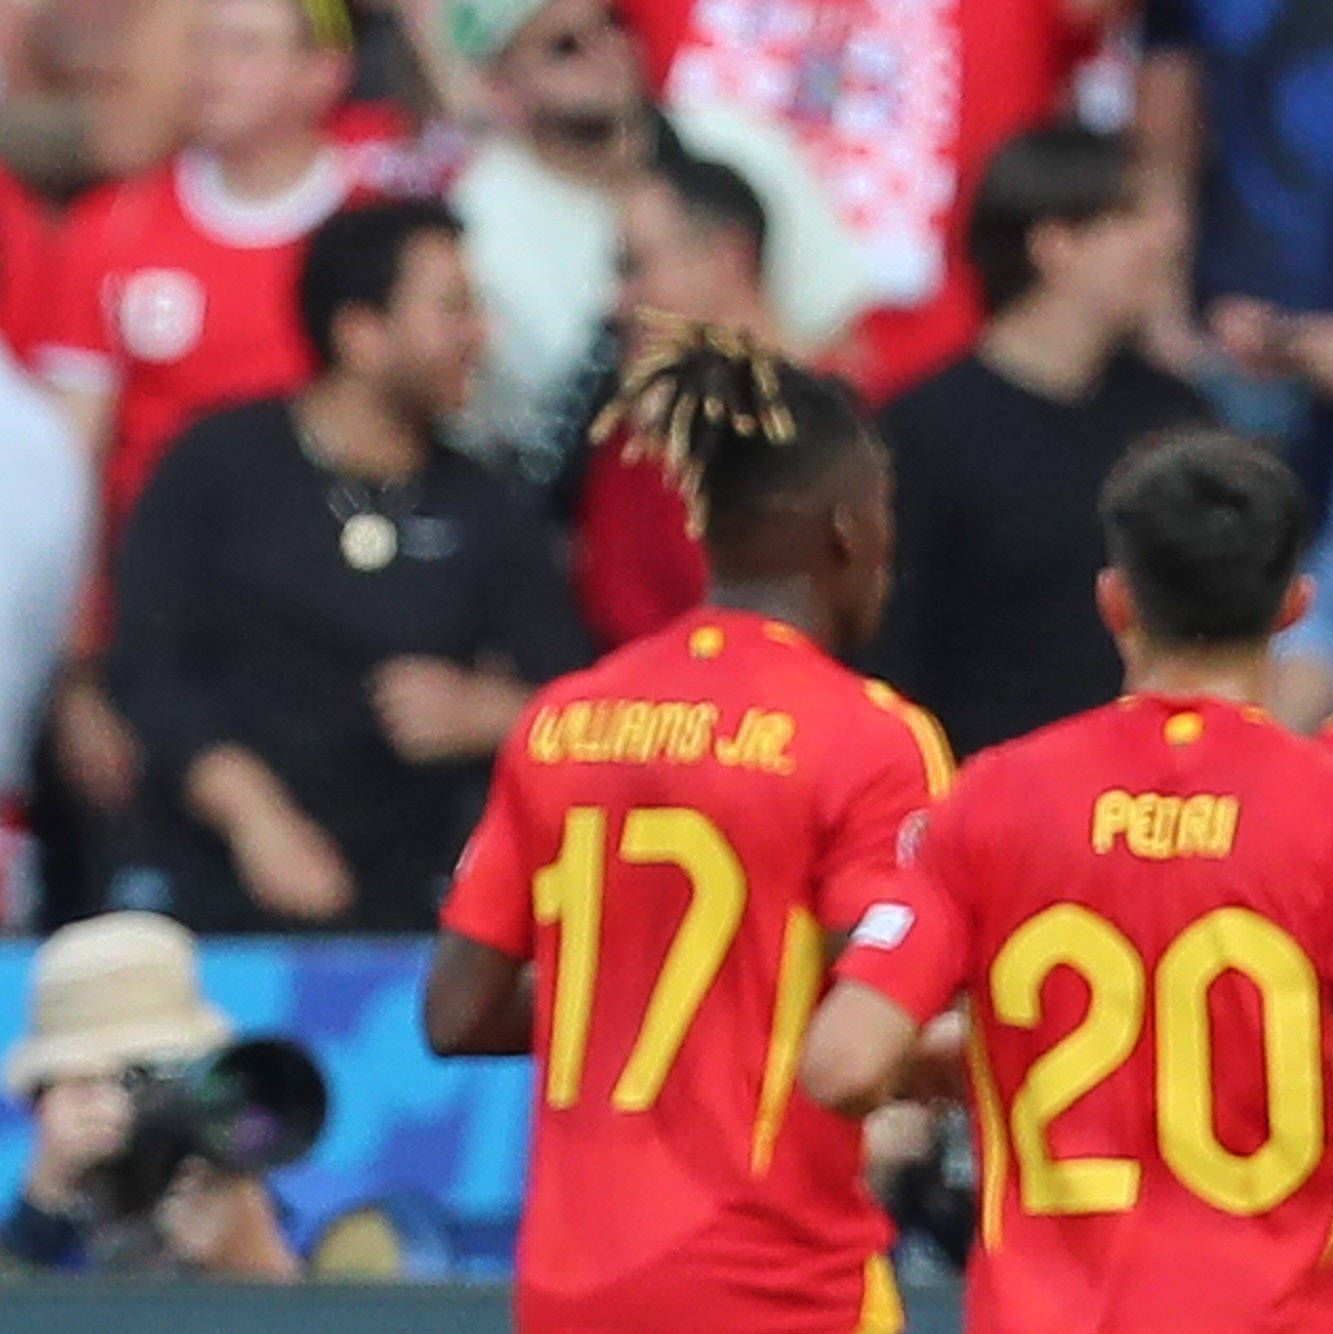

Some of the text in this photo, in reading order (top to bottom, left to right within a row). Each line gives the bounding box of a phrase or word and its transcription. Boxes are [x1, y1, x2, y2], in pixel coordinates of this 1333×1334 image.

[532, 806, 747, 1112] 17
[1092, 788, 1240, 860] PEDRI
[990, 903, 1323, 1215] 20
